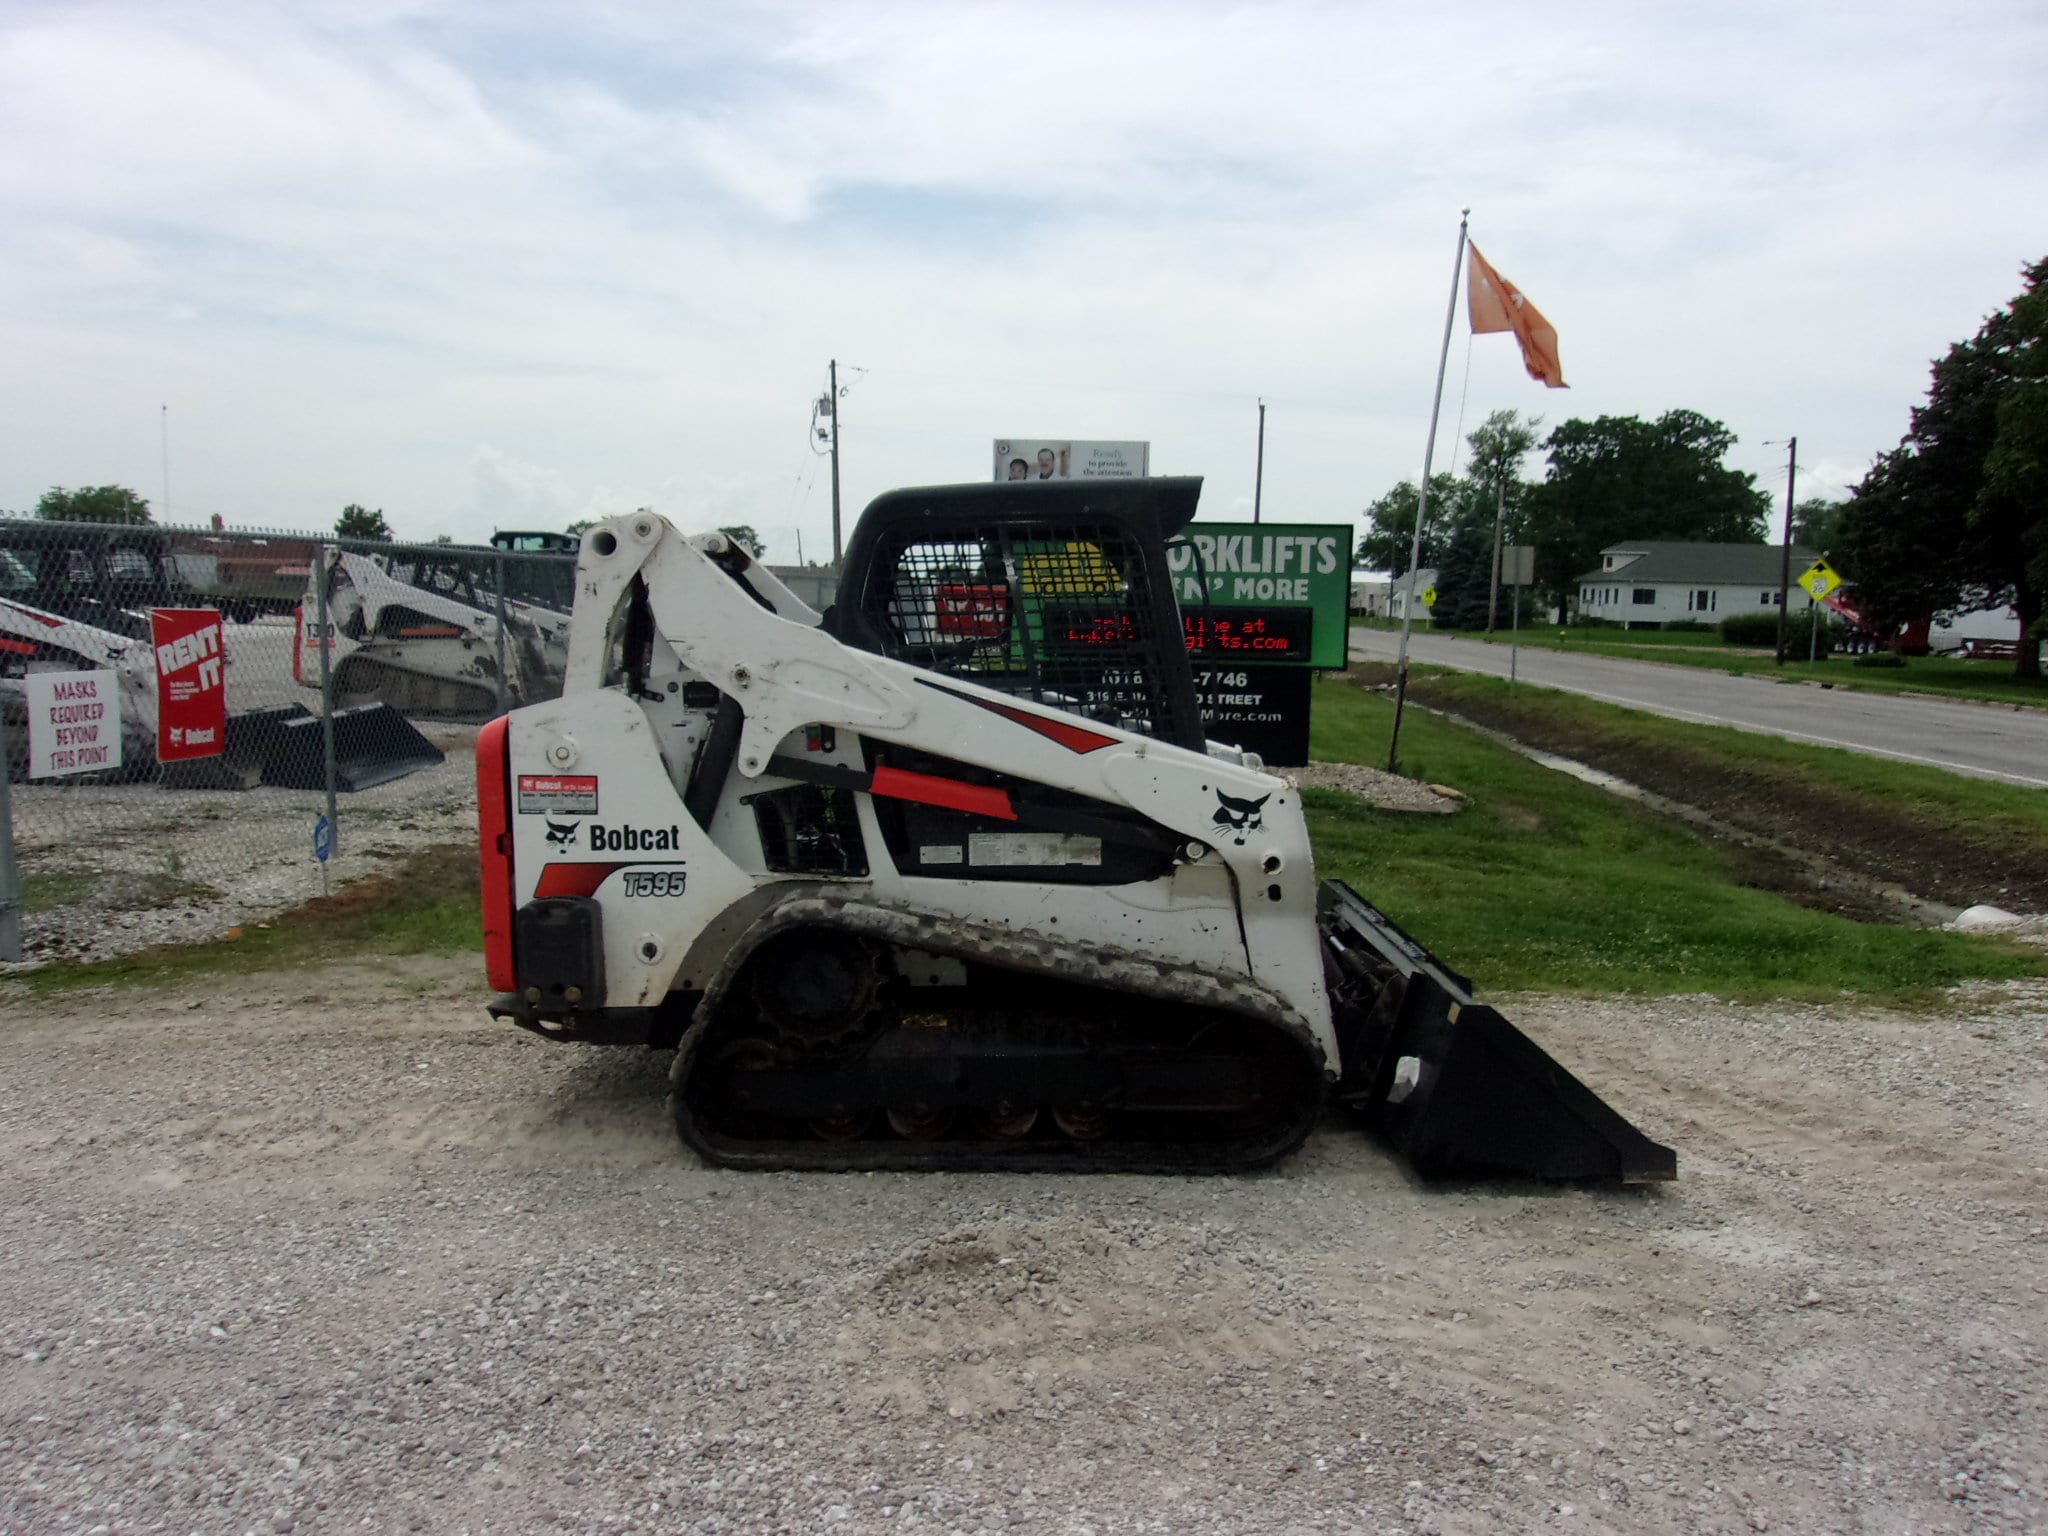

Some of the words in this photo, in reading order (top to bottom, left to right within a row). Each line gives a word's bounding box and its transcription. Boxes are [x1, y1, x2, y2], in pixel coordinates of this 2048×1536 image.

[1165, 534, 1337, 575] ORKLIFTS
[1233, 578, 1309, 601] MORE
[1242, 619, 1265, 633] at
[156, 624, 219, 676] RENT
[198, 656, 221, 691] IT
[54, 680, 97, 700] MASKS
[50, 703, 104, 725] REQUIRED
[56, 725, 98, 746] BEYOND
[50, 749, 75, 770] THIS
[78, 745, 109, 767] POINT
[590, 825, 680, 851] Bobcat
[623, 872, 686, 897] T595
